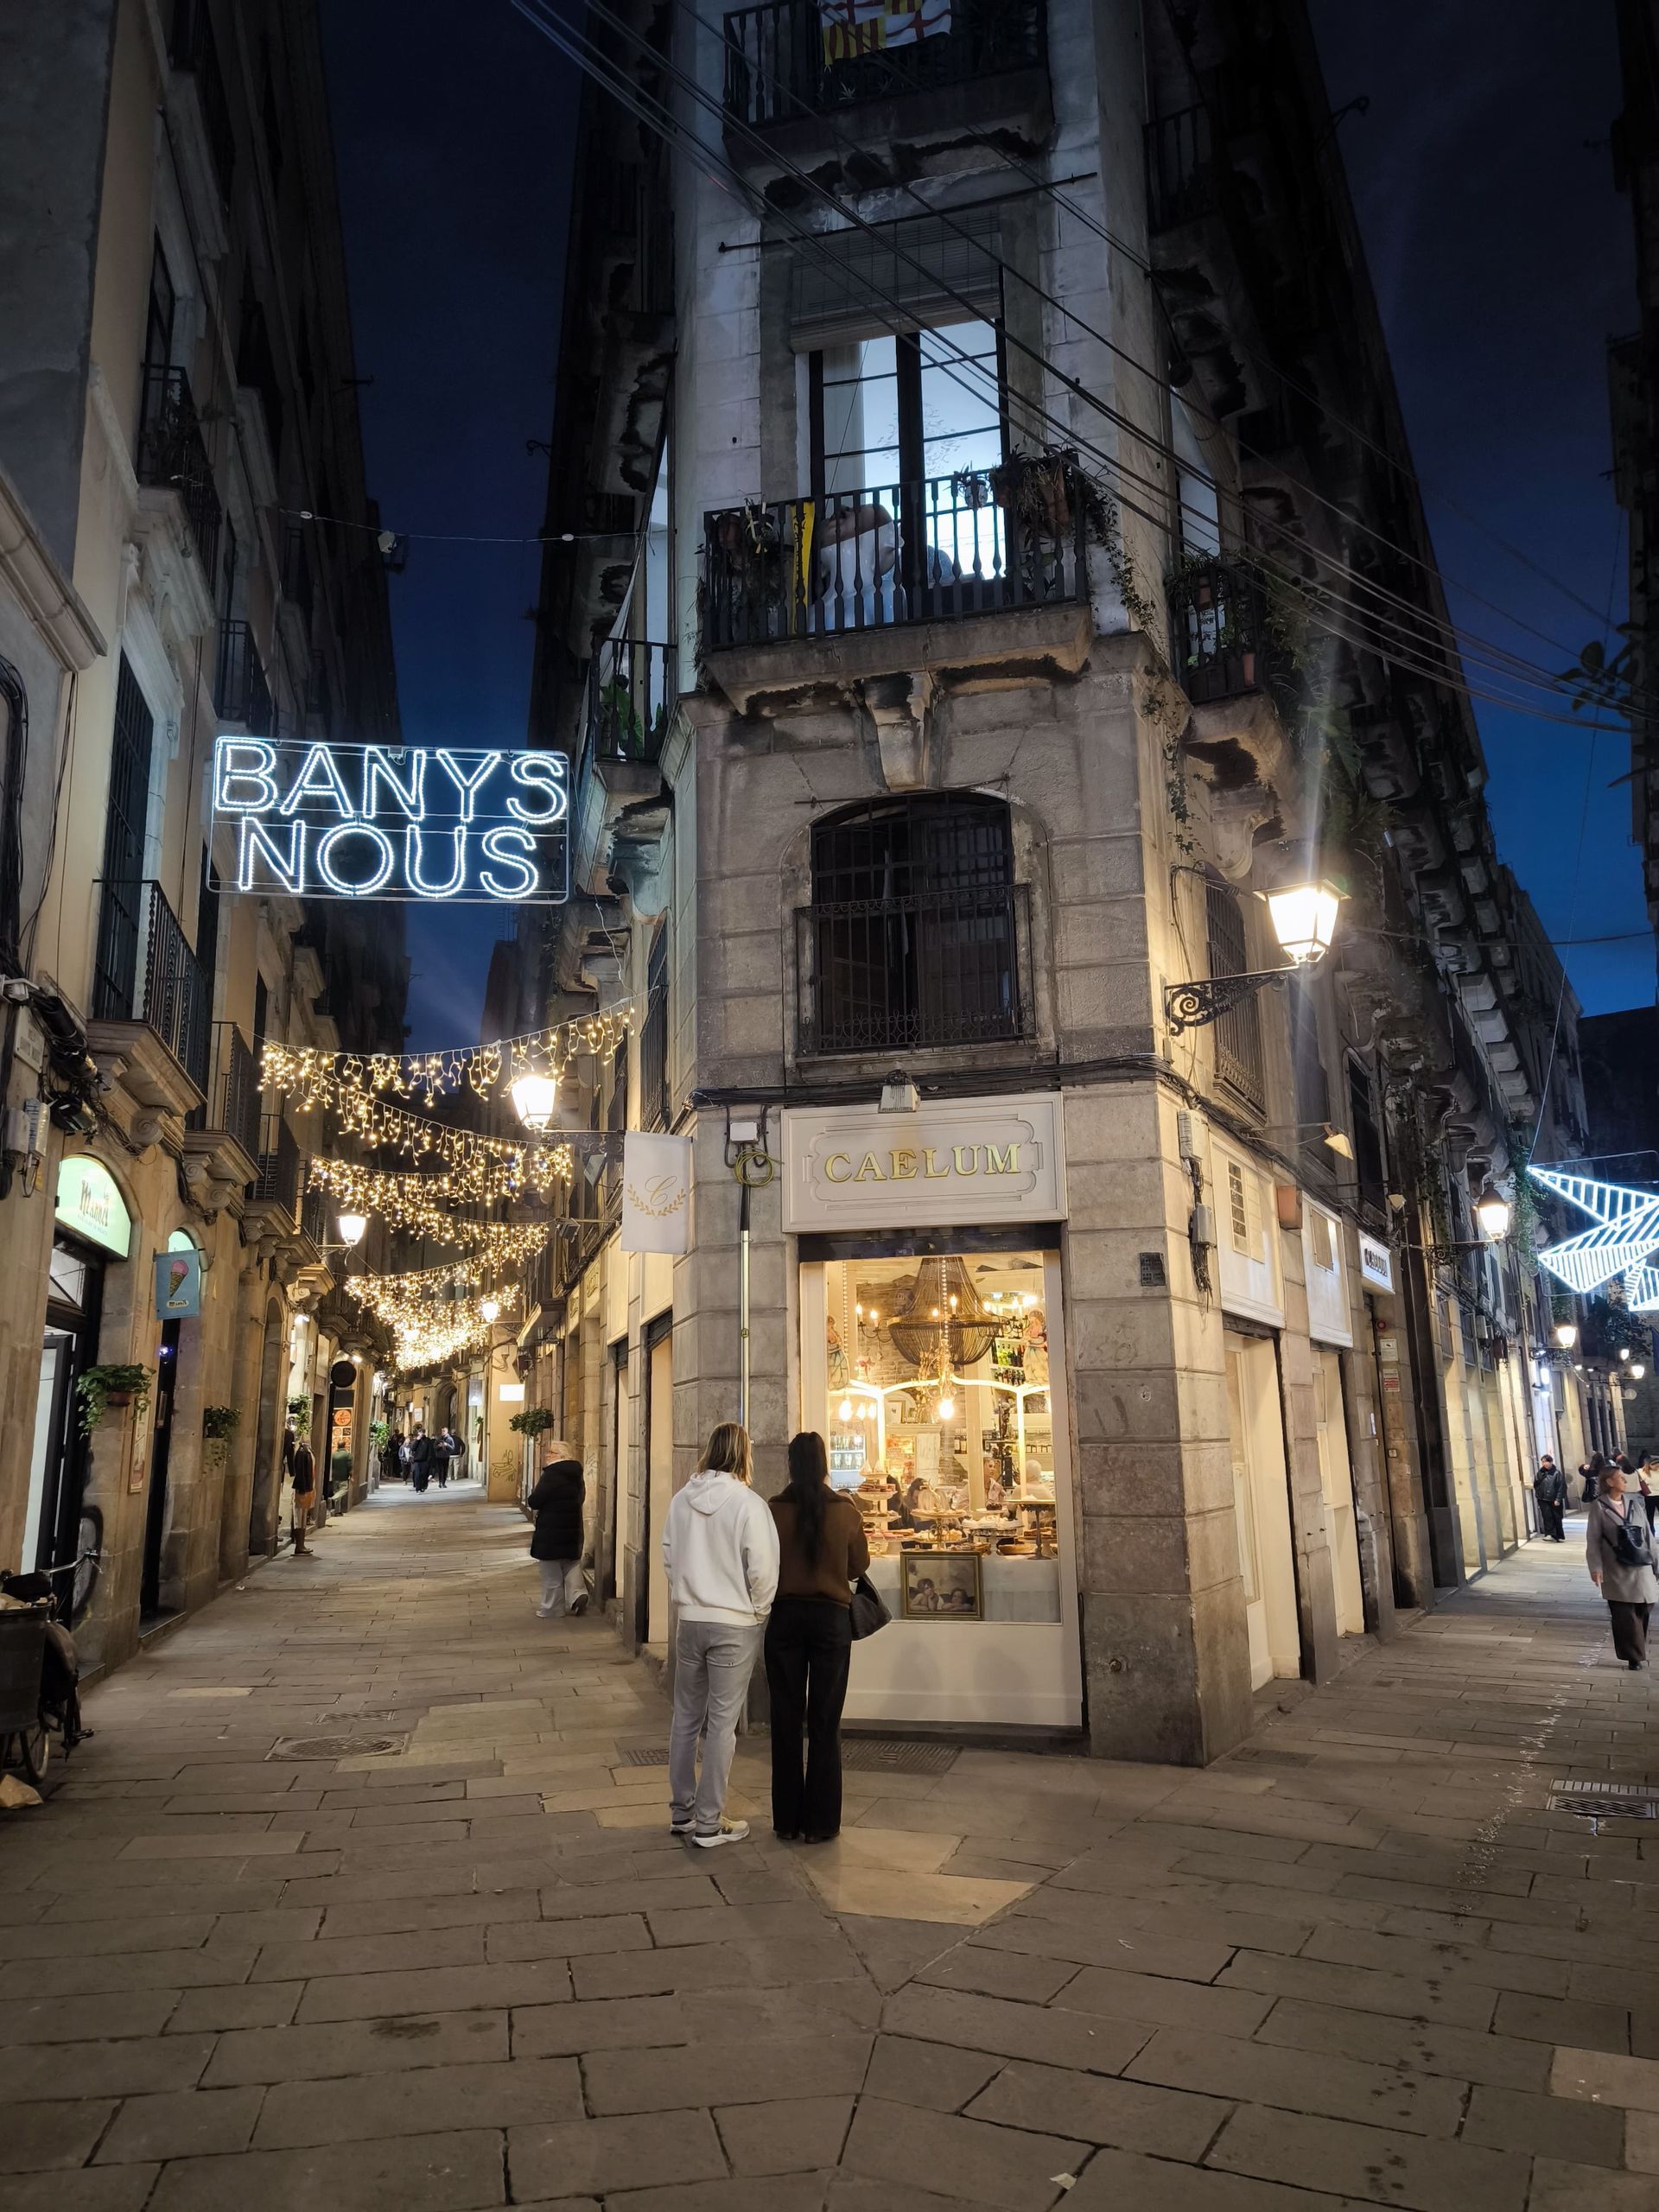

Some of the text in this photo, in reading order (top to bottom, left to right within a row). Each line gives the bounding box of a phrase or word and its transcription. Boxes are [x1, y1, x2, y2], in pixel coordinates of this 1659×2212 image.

[213, 736, 568, 824] BANYS
[238, 816, 540, 899] NOUS
[823, 1142, 1021, 1183] CAELUM
